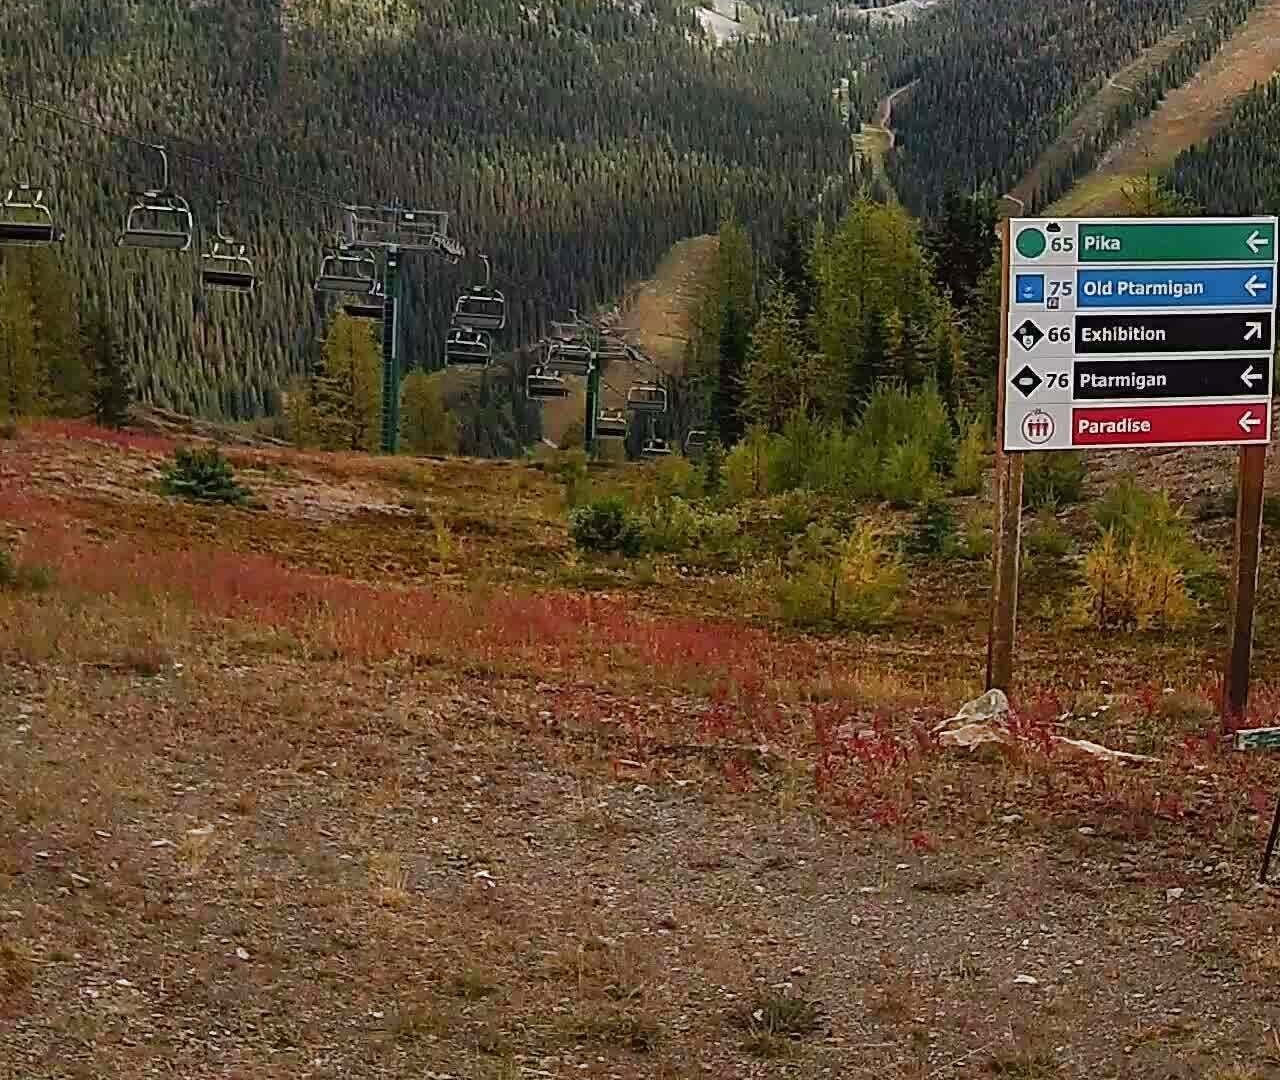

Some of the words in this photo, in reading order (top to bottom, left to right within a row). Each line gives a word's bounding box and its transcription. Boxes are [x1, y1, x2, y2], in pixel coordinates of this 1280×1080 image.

[1051, 237, 1074, 252] 65
[1084, 235, 1120, 251] Pika
[1049, 281, 1073, 296] 75
[1083, 280, 1112, 296] Old
[1118, 280, 1204, 298] Ptarmigan
[1048, 327, 1071, 342] 66
[1081, 326, 1166, 342] Exhibition
[1046, 373, 1069, 388] 76
[1080, 371, 1167, 390] Ptarmigan
[1078, 418, 1151, 434] Paradise
